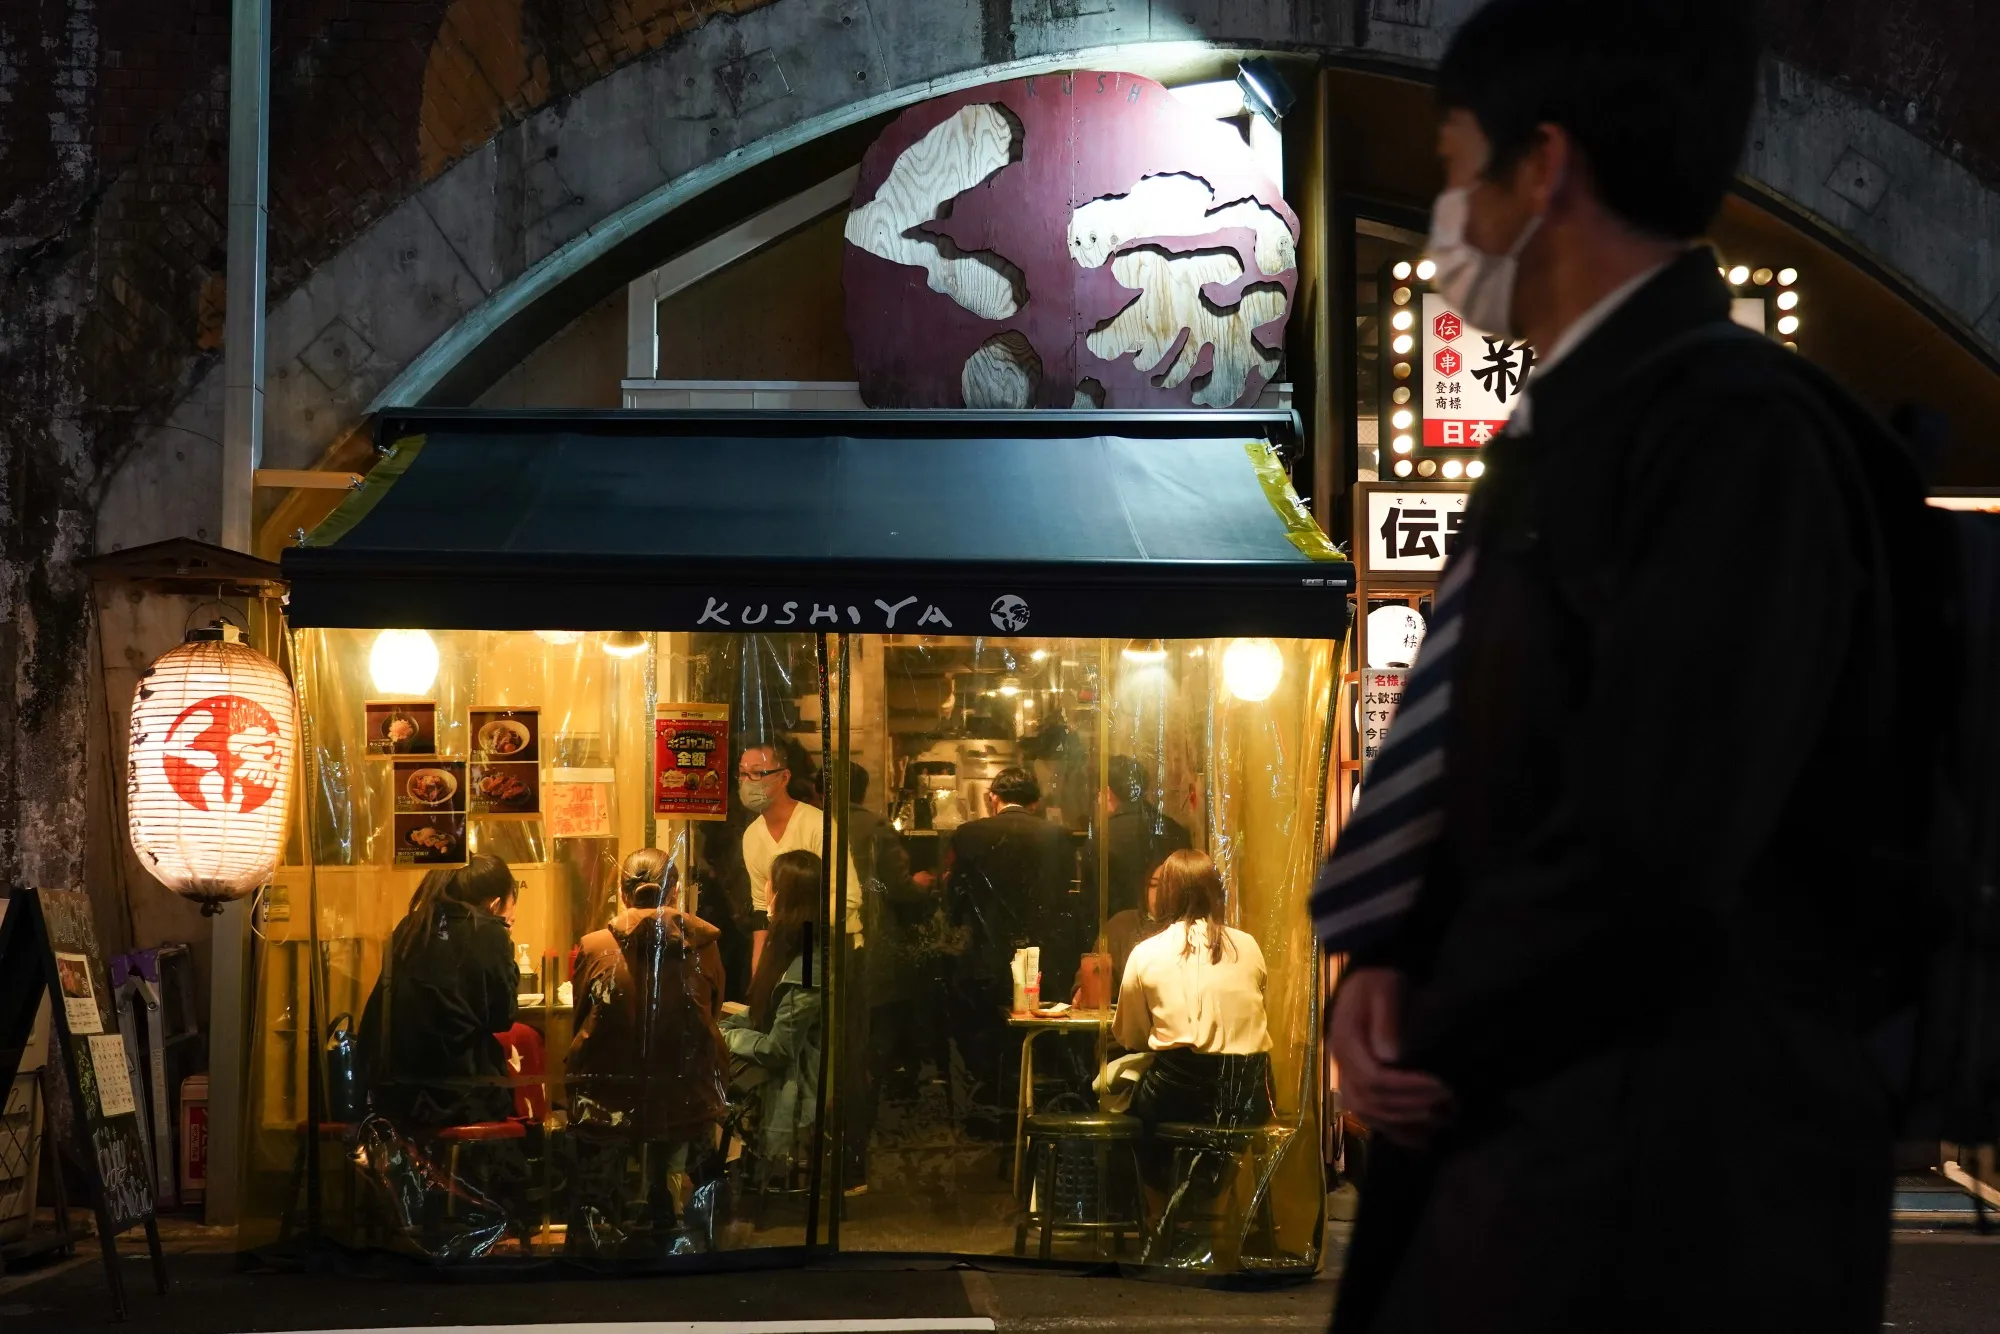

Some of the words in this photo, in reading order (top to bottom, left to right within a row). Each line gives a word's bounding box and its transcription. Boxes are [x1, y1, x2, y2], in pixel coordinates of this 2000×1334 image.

[1435, 381, 1462, 394] 登録
[1435, 397, 1462, 410] 商標
[697, 596, 952, 628] KUSHIYA
[1365, 692, 1402, 704] 大歓迎
[677, 751, 706, 767] 全額
